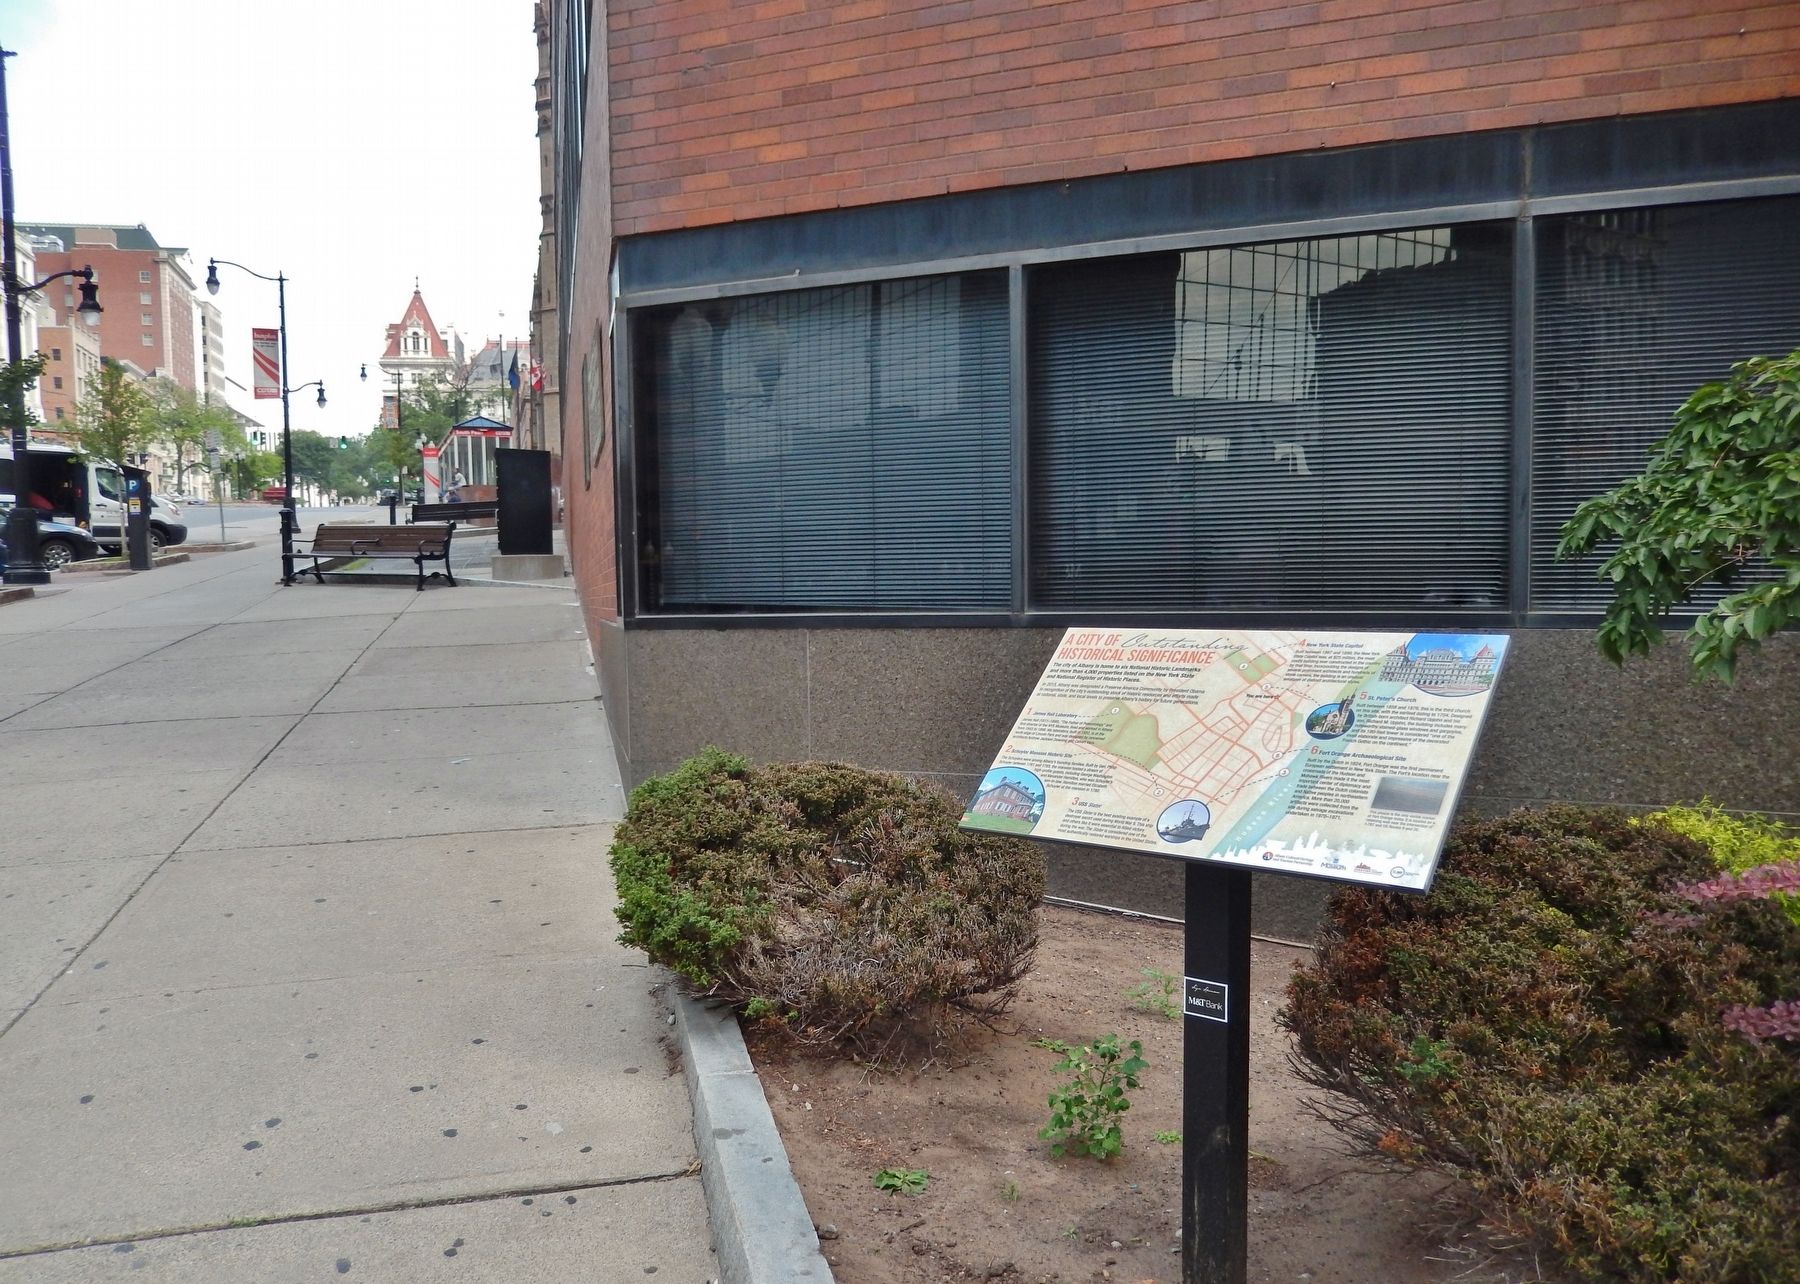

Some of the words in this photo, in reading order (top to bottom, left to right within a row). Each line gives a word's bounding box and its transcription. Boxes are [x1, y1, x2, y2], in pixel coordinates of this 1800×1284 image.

[129, 480, 136, 490] P
[1066, 634, 1074, 645] A
[1076, 634, 1104, 646] CITY
[1105, 634, 1122, 646] OF
[1122, 633, 1249, 660] Outstanding
[1058, 648, 1124, 662] HISTORICAL
[1128, 650, 1216, 664] SIGNIFICANCE
[1360, 692, 1368, 700] 5
[1311, 746, 1319, 754] 6
[1071, 797, 1080, 806] 3
[1188, 996, 1206, 1006] M&T
[1206, 1000, 1222, 1010] Bank
